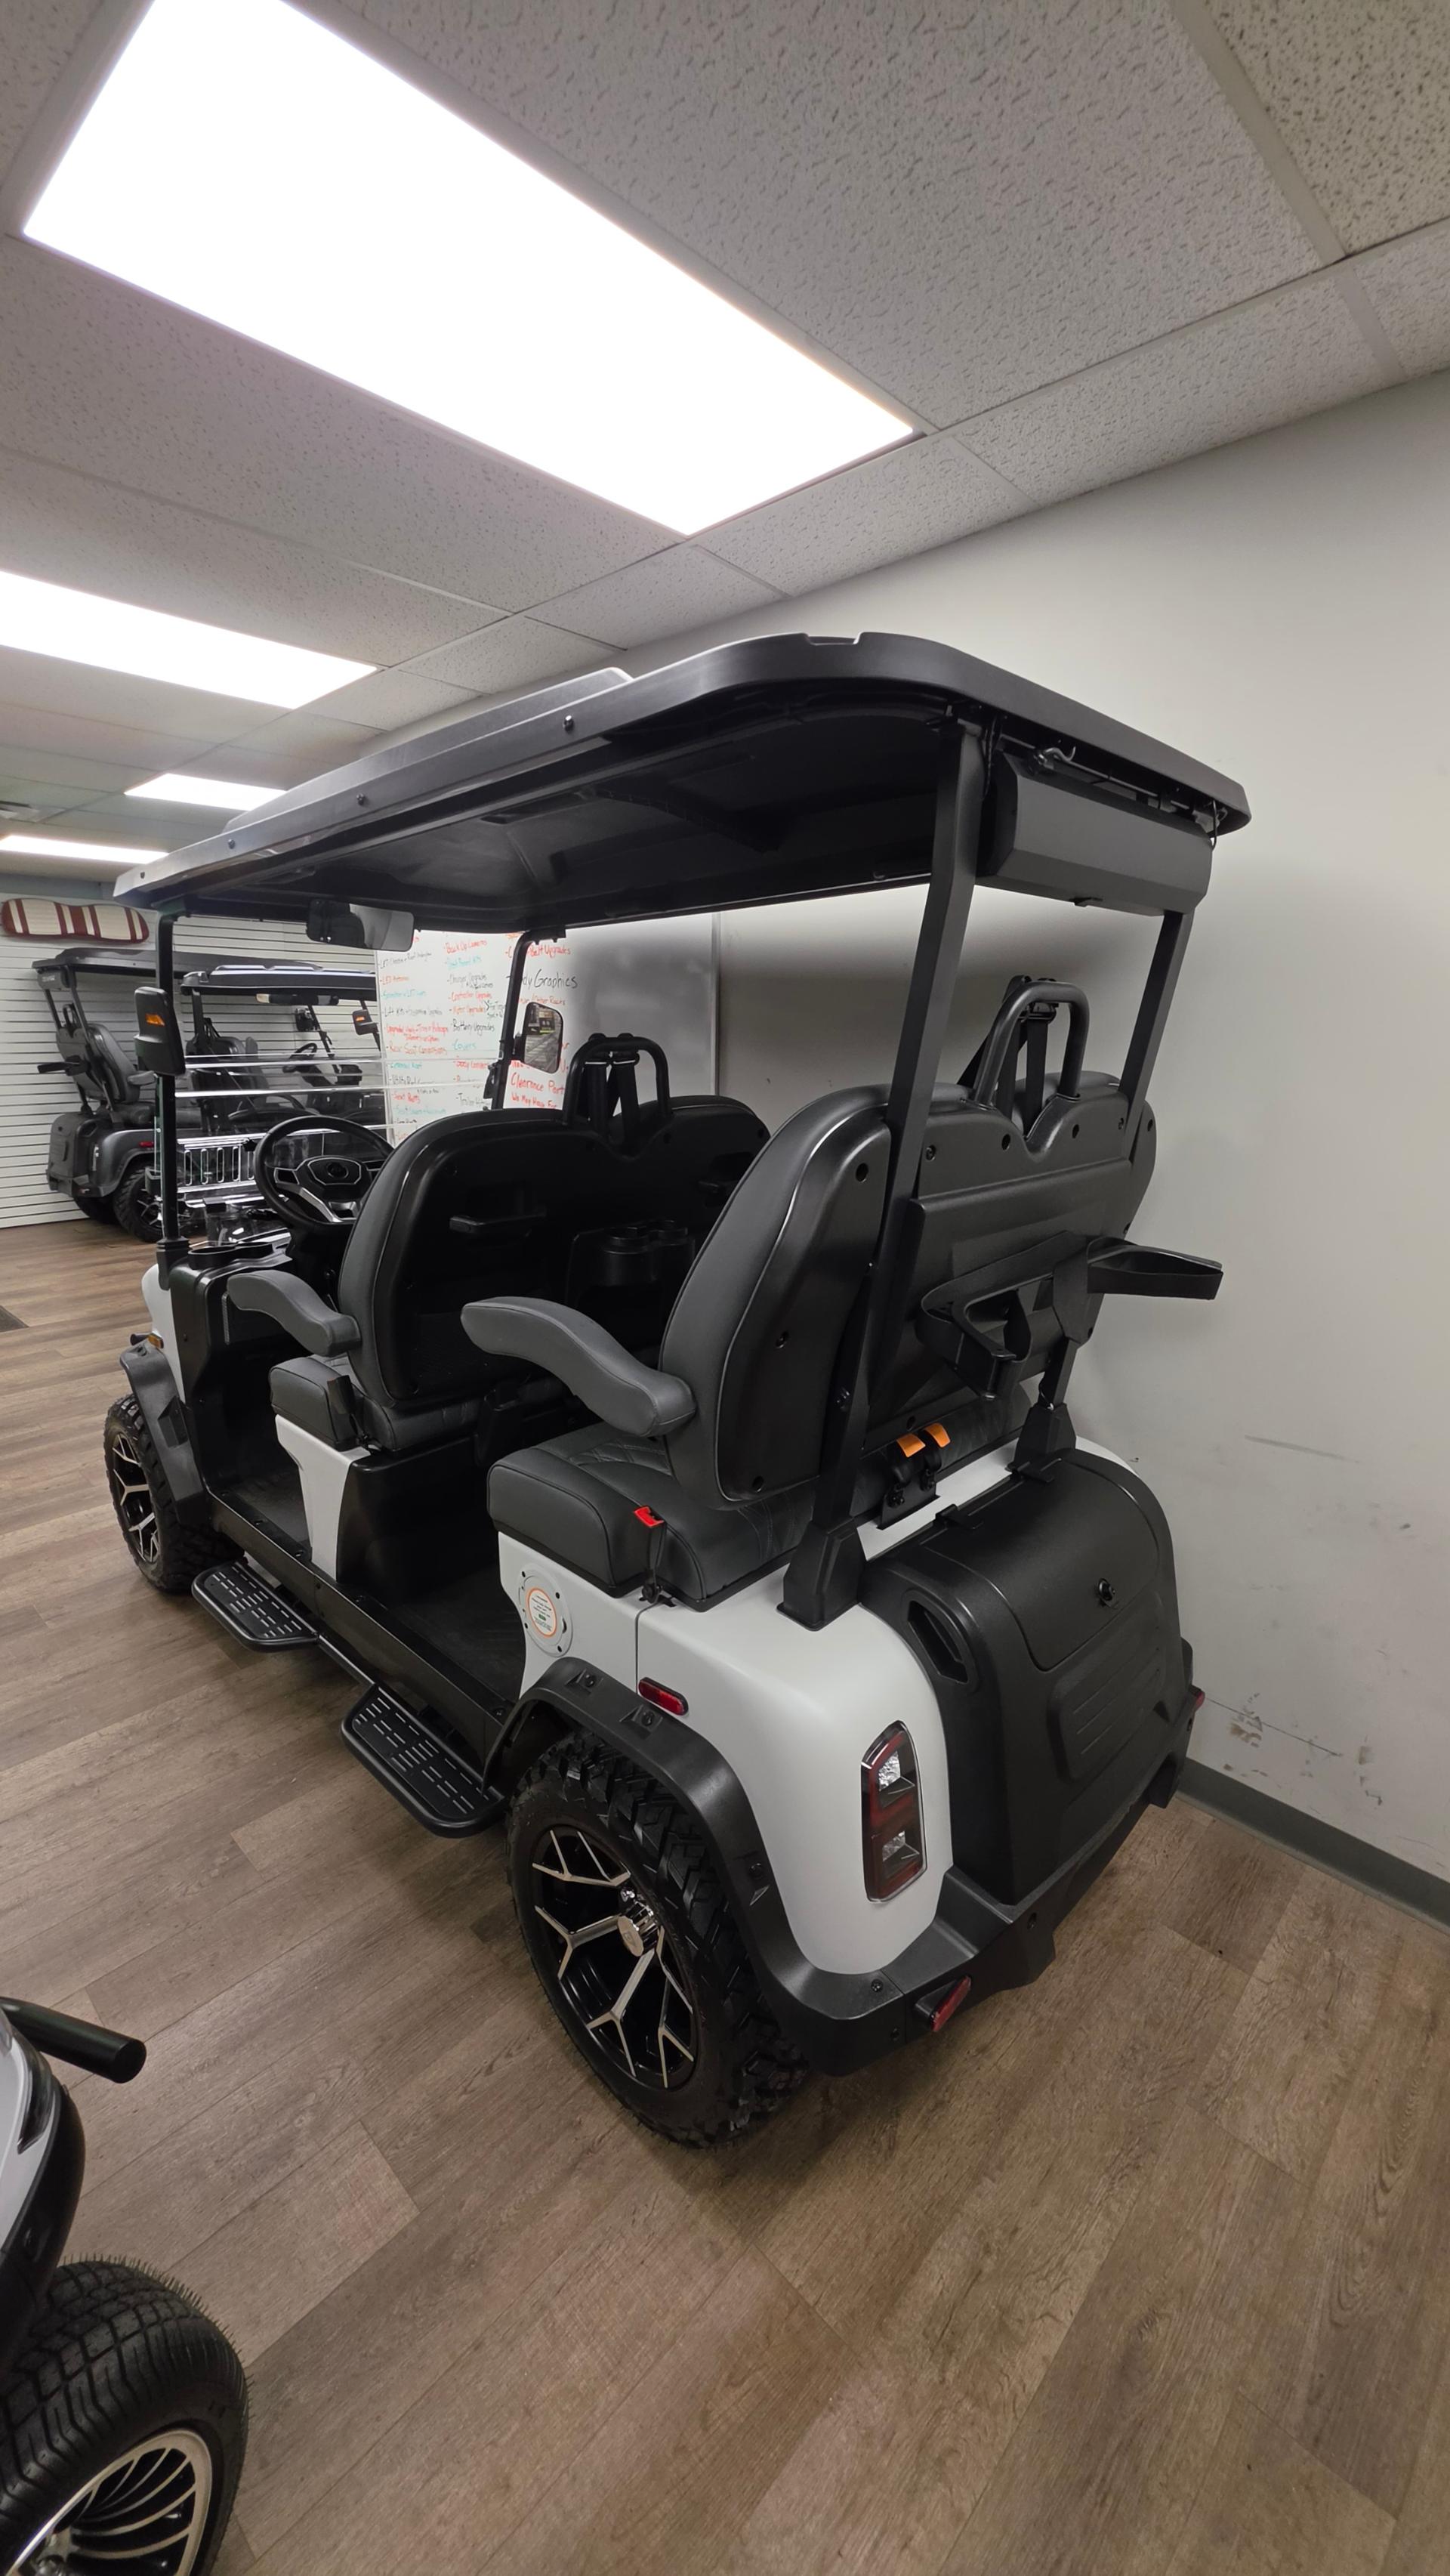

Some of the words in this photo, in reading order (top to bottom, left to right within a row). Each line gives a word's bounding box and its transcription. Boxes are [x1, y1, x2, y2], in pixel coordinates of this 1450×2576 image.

[534, 968, 578, 990] Graphics
[453, 1018, 472, 1034] Battery
[511, 1072, 545, 1092] Clearance
[548, 1080, 565, 1095] Part
